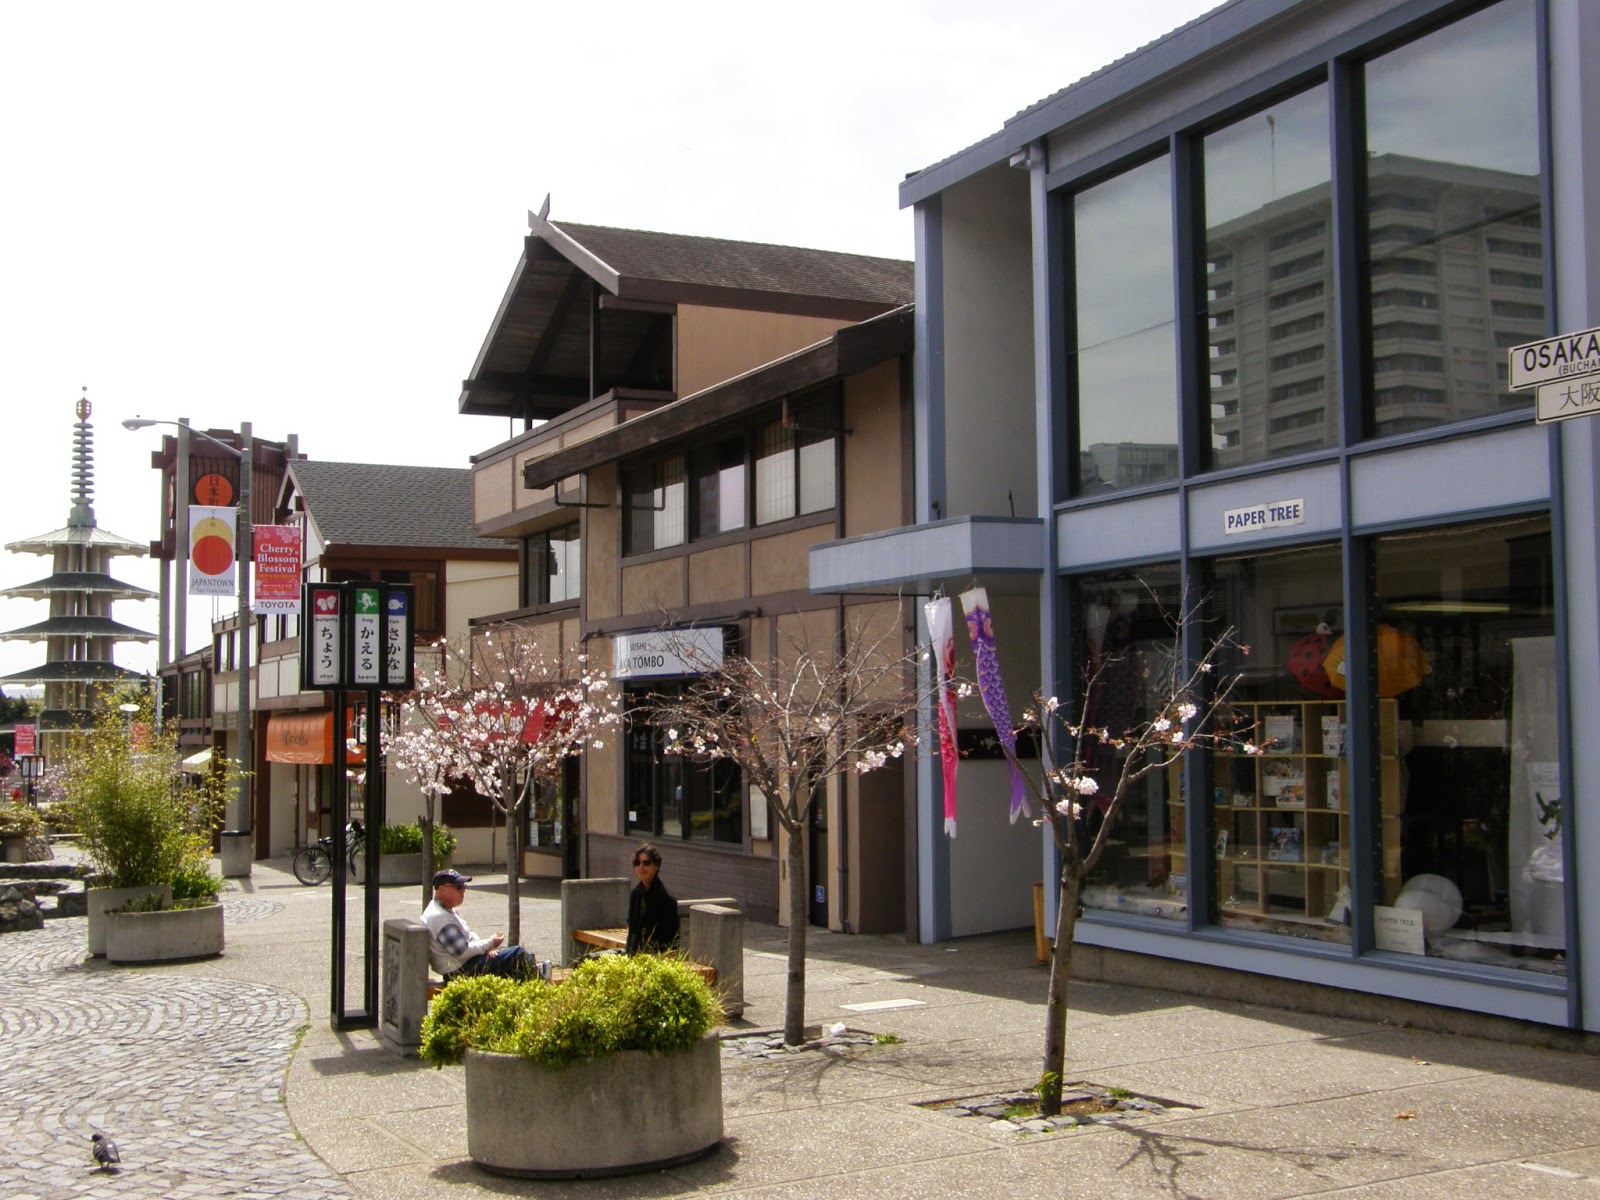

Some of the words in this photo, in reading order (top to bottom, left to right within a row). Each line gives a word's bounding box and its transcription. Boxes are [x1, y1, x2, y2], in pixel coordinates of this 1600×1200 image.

[1523, 334, 1600, 372] OSAKA
[1559, 358, 1600, 376] (BUCHA
[1559, 381, 1600, 411] 大阪
[1227, 509, 1266, 529] PAPER
[1269, 504, 1300, 522] TREE
[259, 542, 295, 556] Cherry
[257, 553, 299, 563] Blossom
[259, 563, 297, 573] Festival
[191, 577, 234, 588] JAPANTOWN
[259, 601, 296, 609] TOYOTA
[321, 627, 334, 669] ちょう
[360, 626, 375, 670] かえる
[387, 627, 401, 670] さかな
[629, 642, 647, 652] SUSHI
[633, 655, 665, 669] TOMBO
